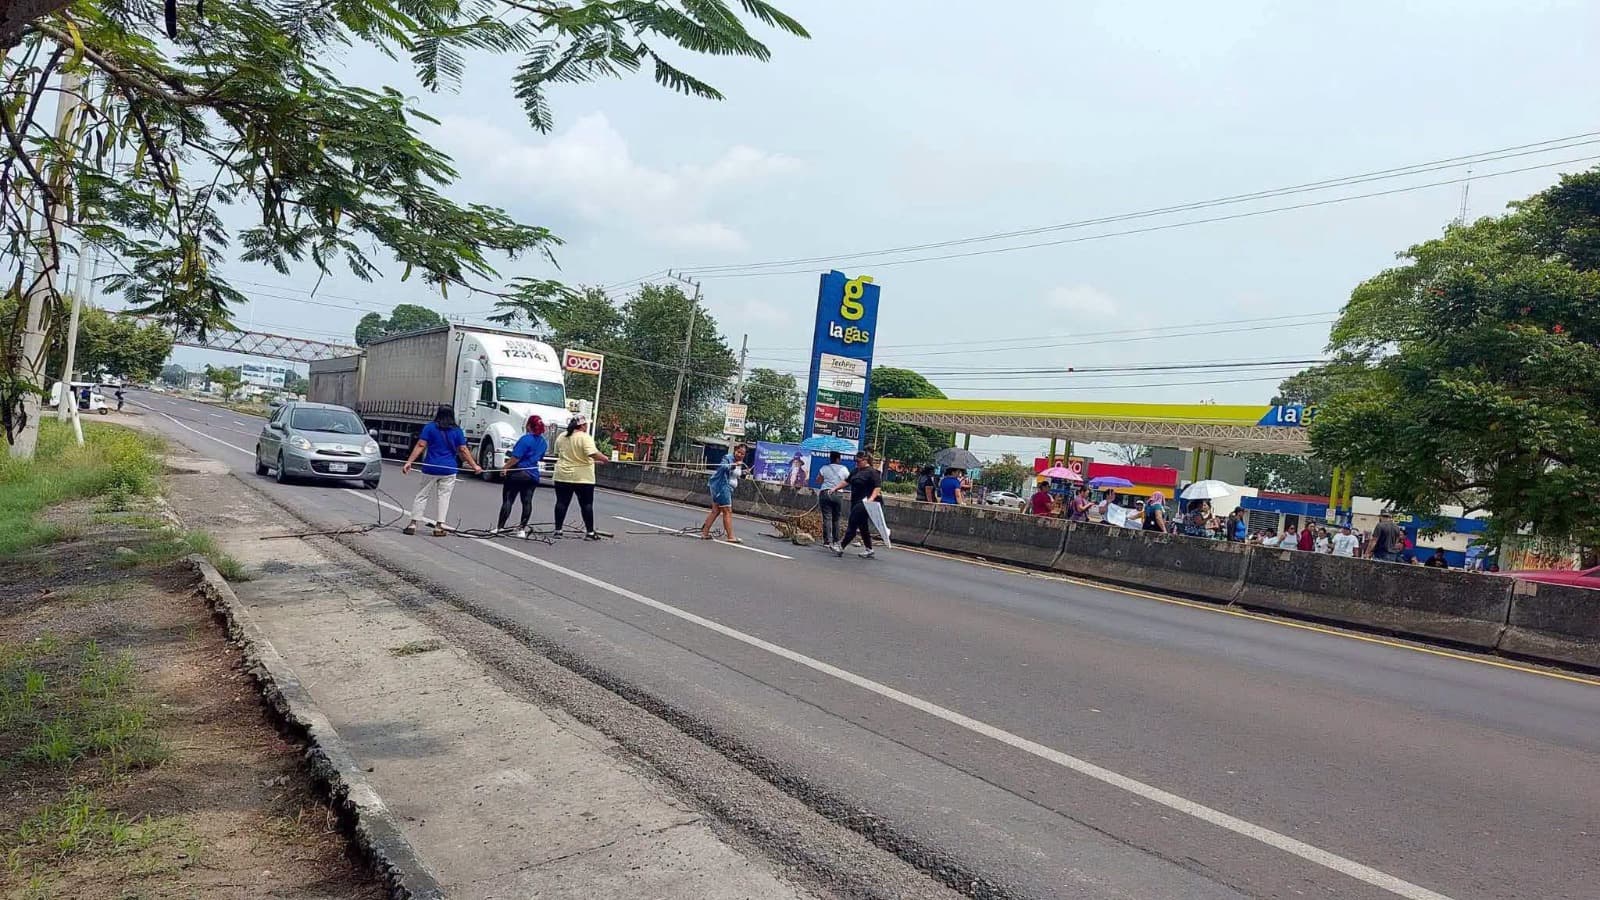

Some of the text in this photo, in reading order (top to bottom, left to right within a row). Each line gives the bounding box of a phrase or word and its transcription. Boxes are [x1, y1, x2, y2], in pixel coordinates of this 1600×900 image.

[830, 321, 869, 343] la gas
[502, 350, 548, 363] T23143
[568, 356, 600, 370] OXXO
[1277, 406, 1297, 422] la
